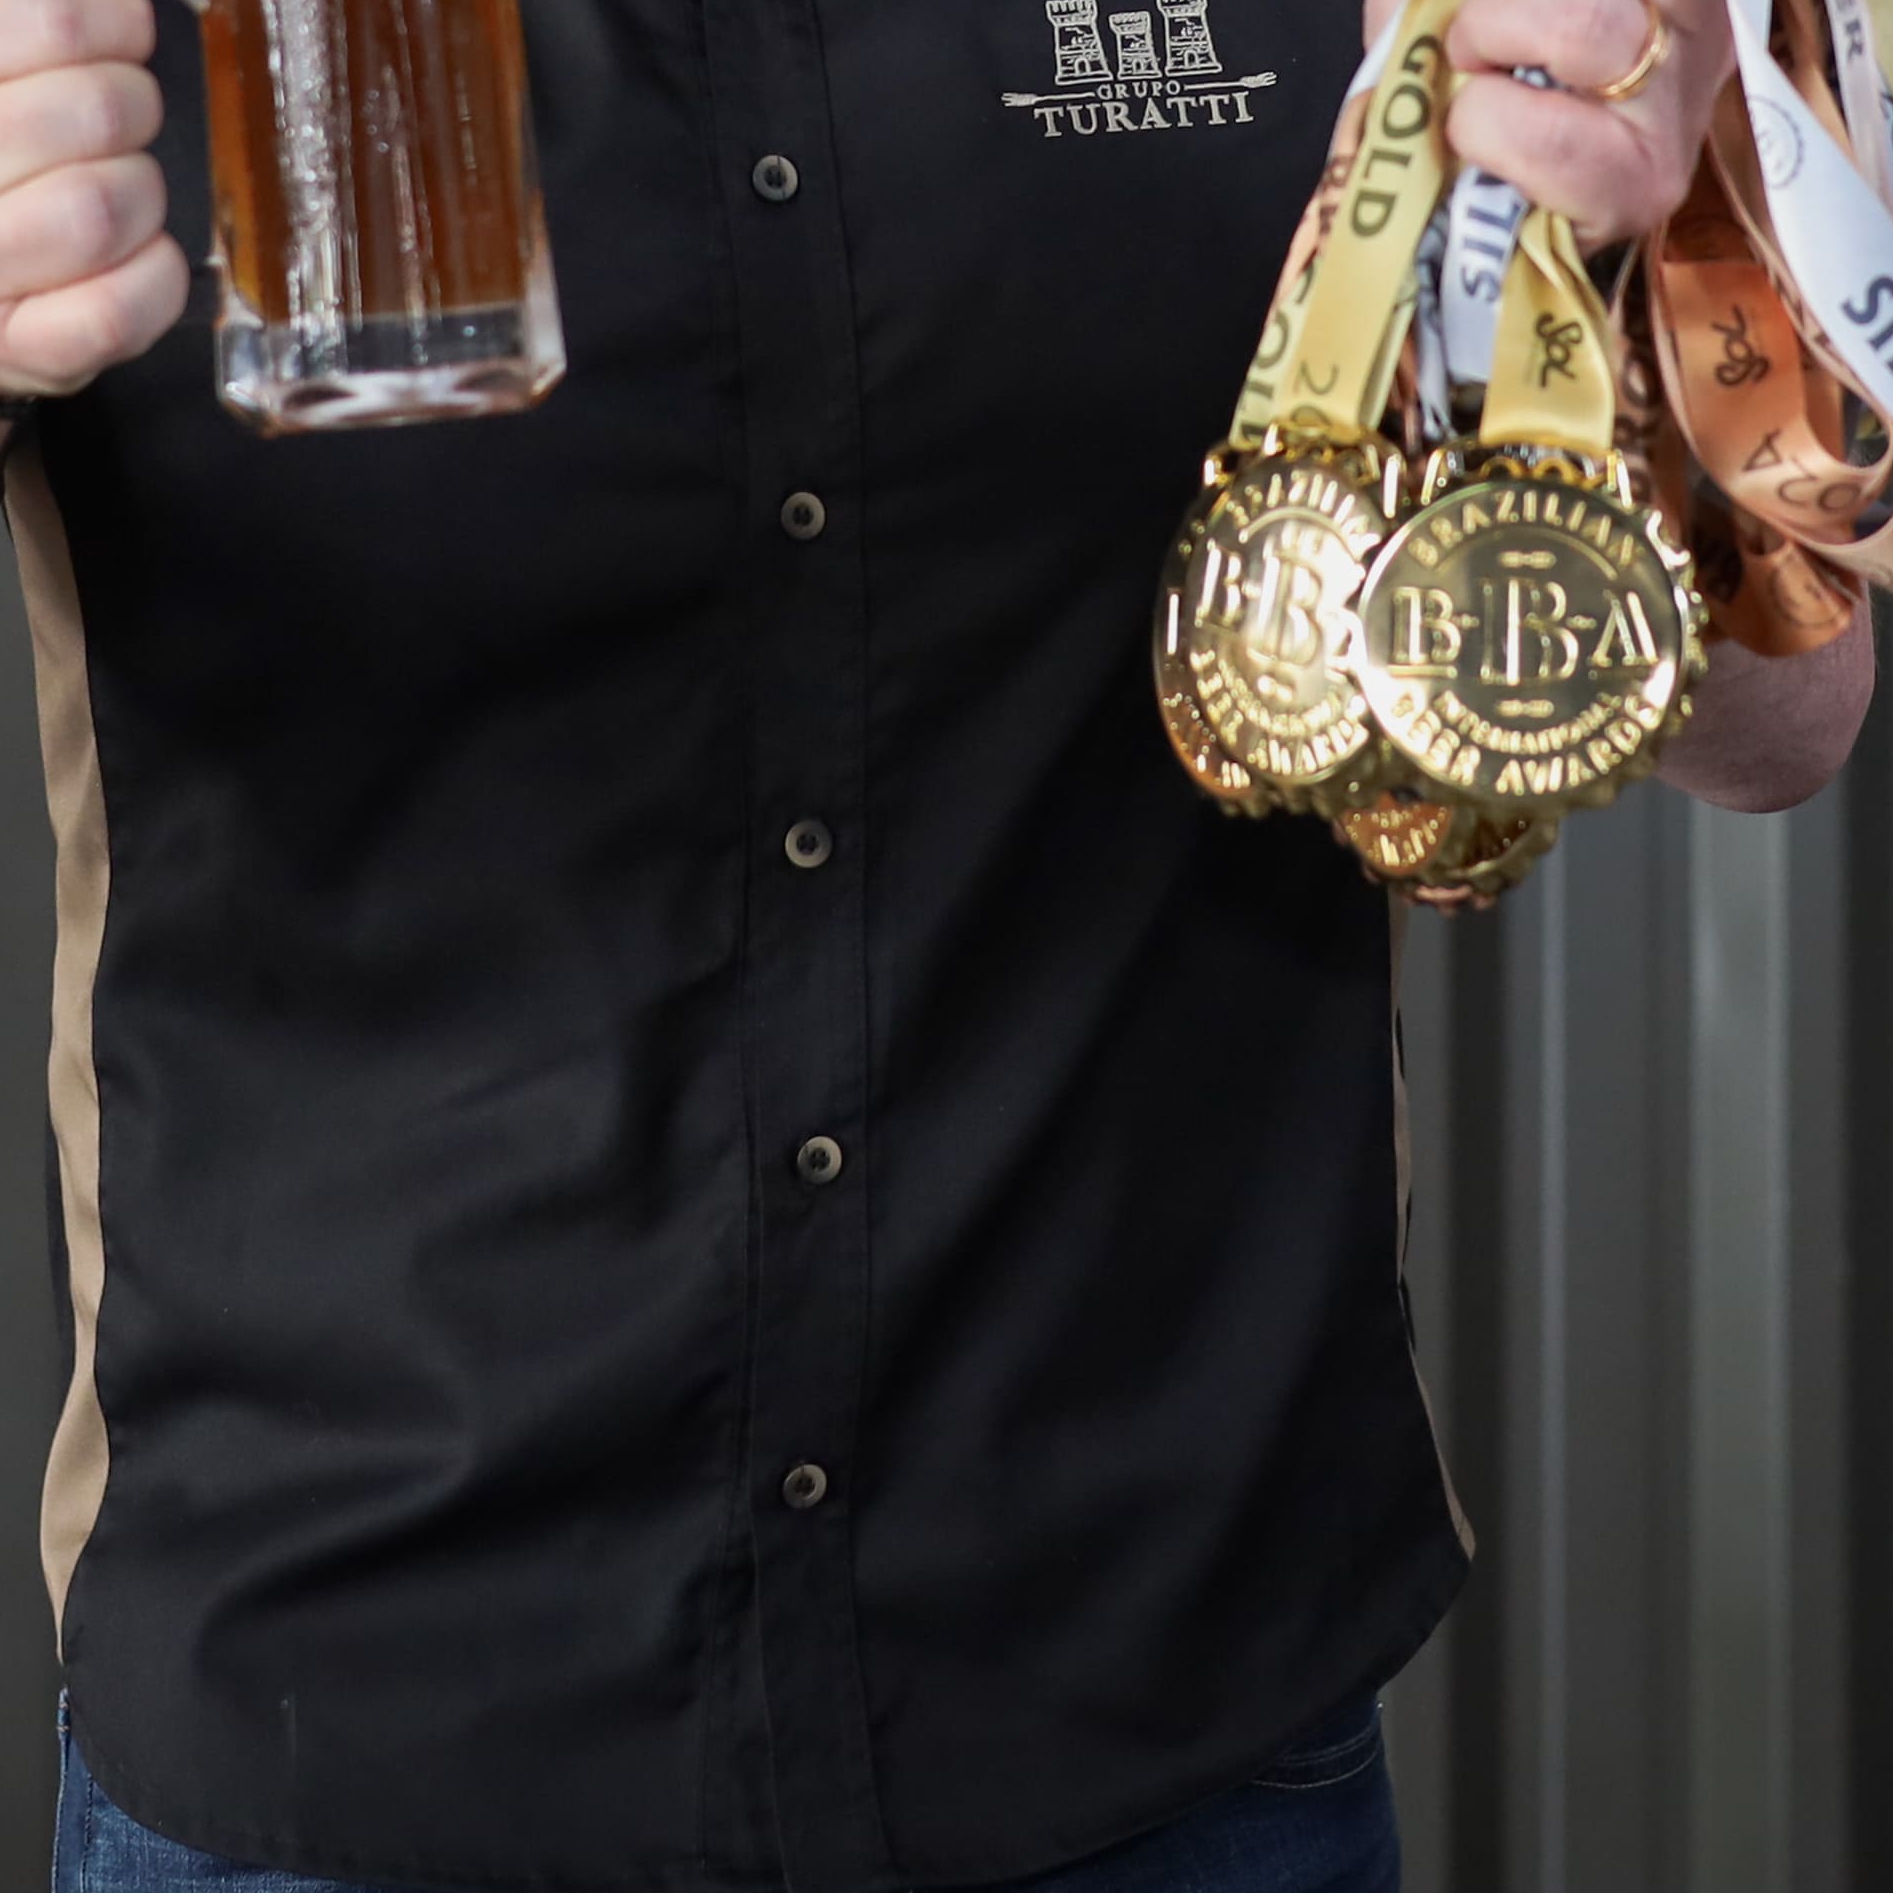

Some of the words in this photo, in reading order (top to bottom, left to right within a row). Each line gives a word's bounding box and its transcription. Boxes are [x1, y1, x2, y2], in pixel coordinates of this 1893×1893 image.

[1096, 79, 1182, 101] GRUPO
[1034, 91, 1255, 138] TURATTI
[1349, 34, 1441, 238] GOLD
